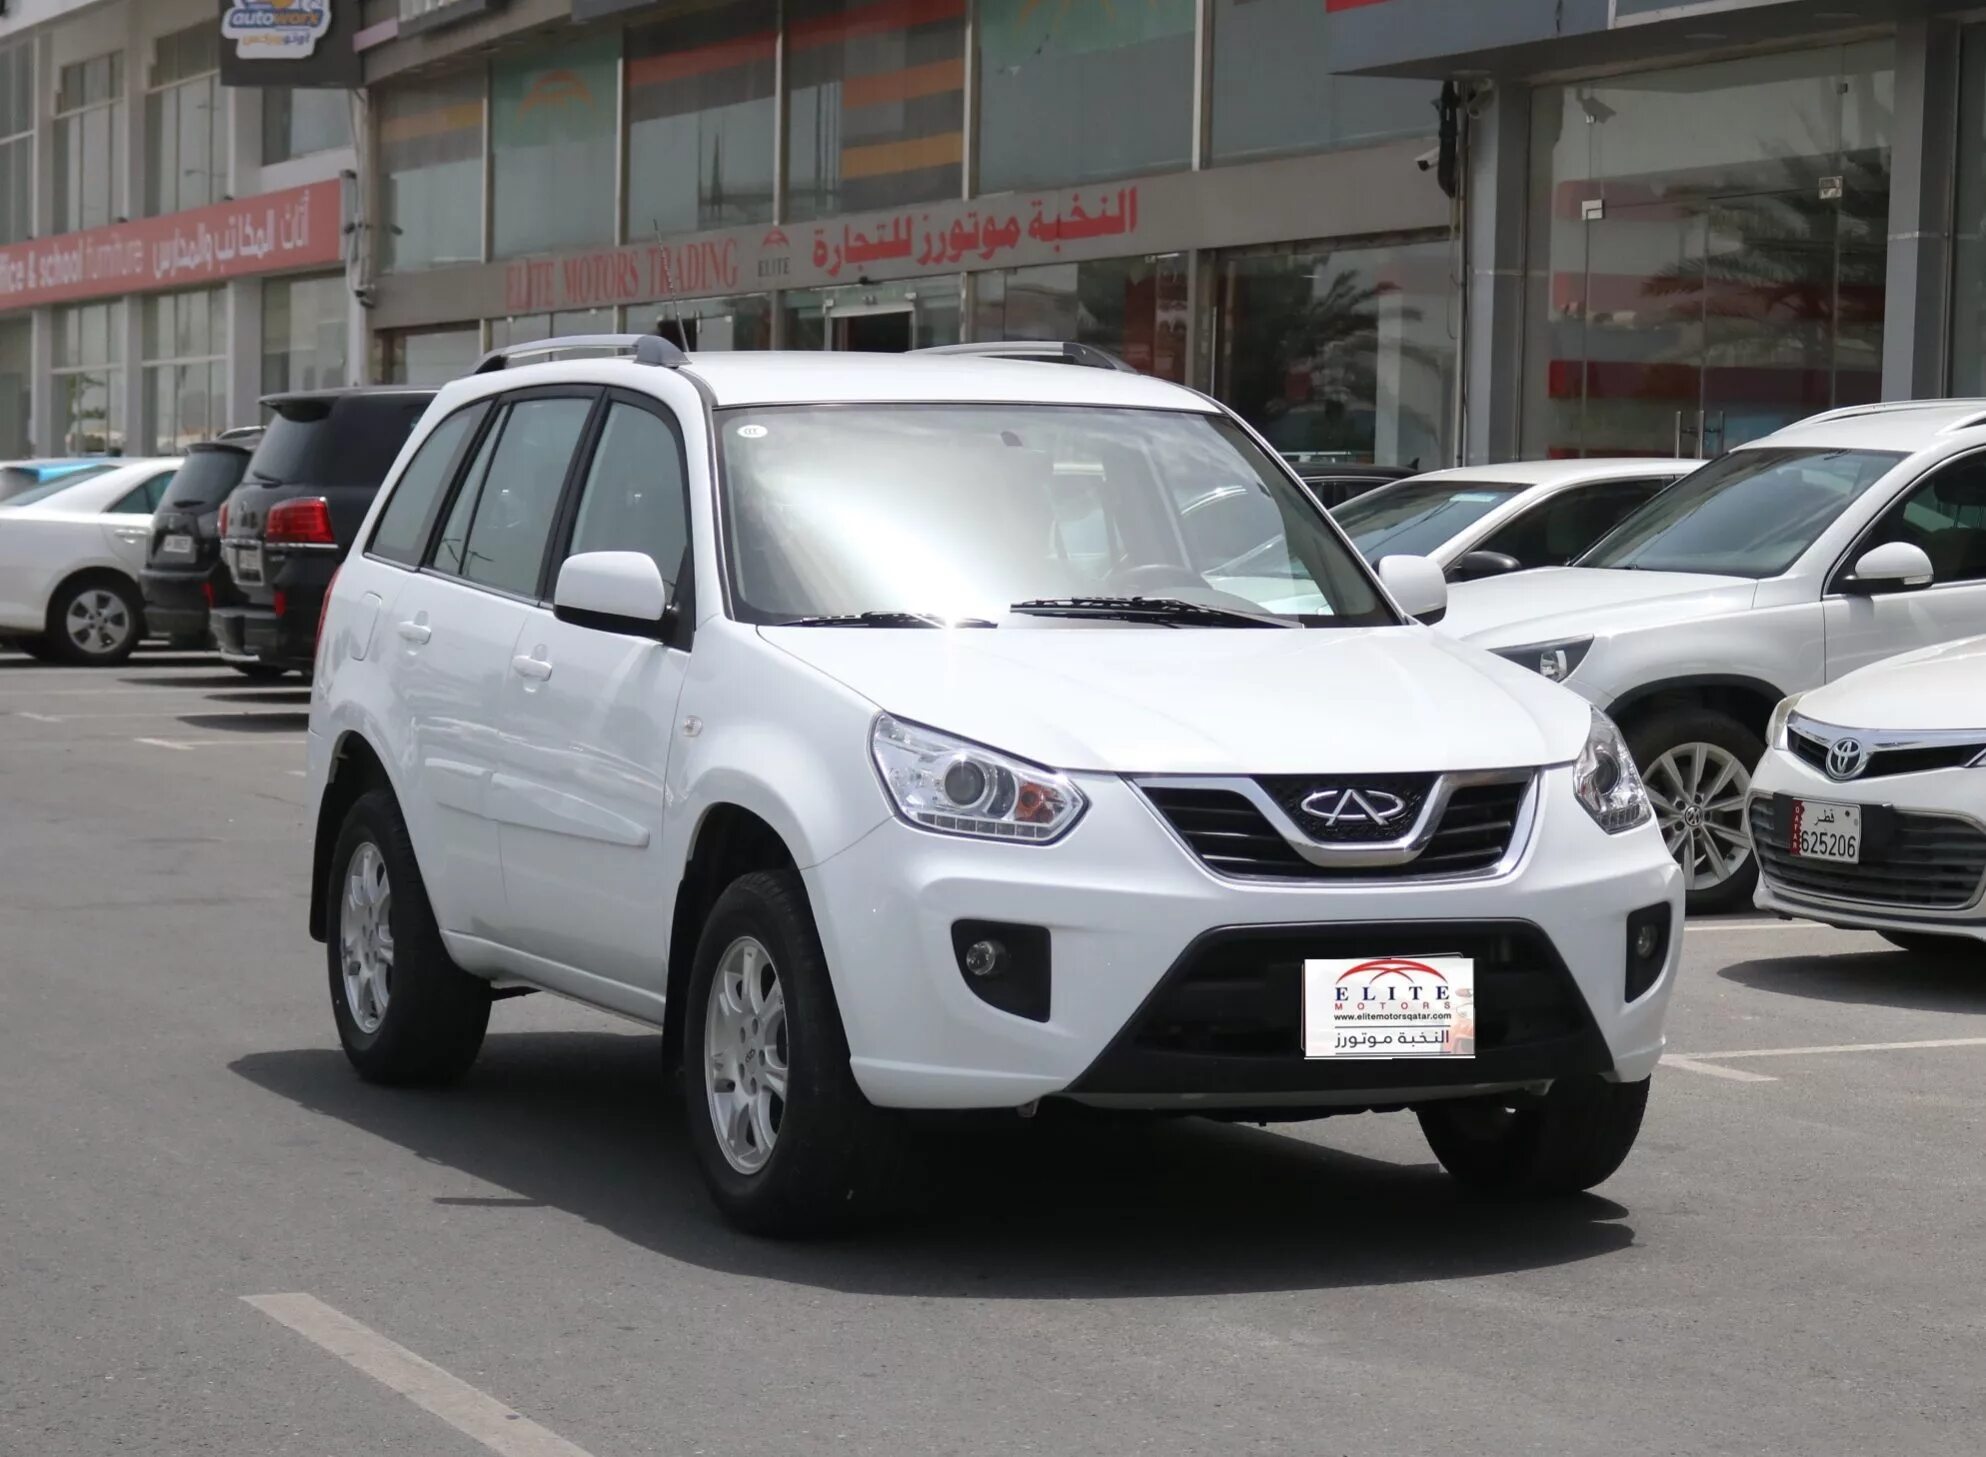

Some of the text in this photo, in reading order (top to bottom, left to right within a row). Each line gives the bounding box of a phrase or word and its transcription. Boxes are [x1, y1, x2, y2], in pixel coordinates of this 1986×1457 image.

[812, 187, 1138, 278] النخبة موتورز للتجارة
[40, 241, 83, 288] school
[506, 237, 740, 311] ELITE MOTORS TRADING
[757, 256, 791, 279] ELITE
[1813, 808, 1835, 827] قطر
[1801, 830, 1857, 858] 625206
